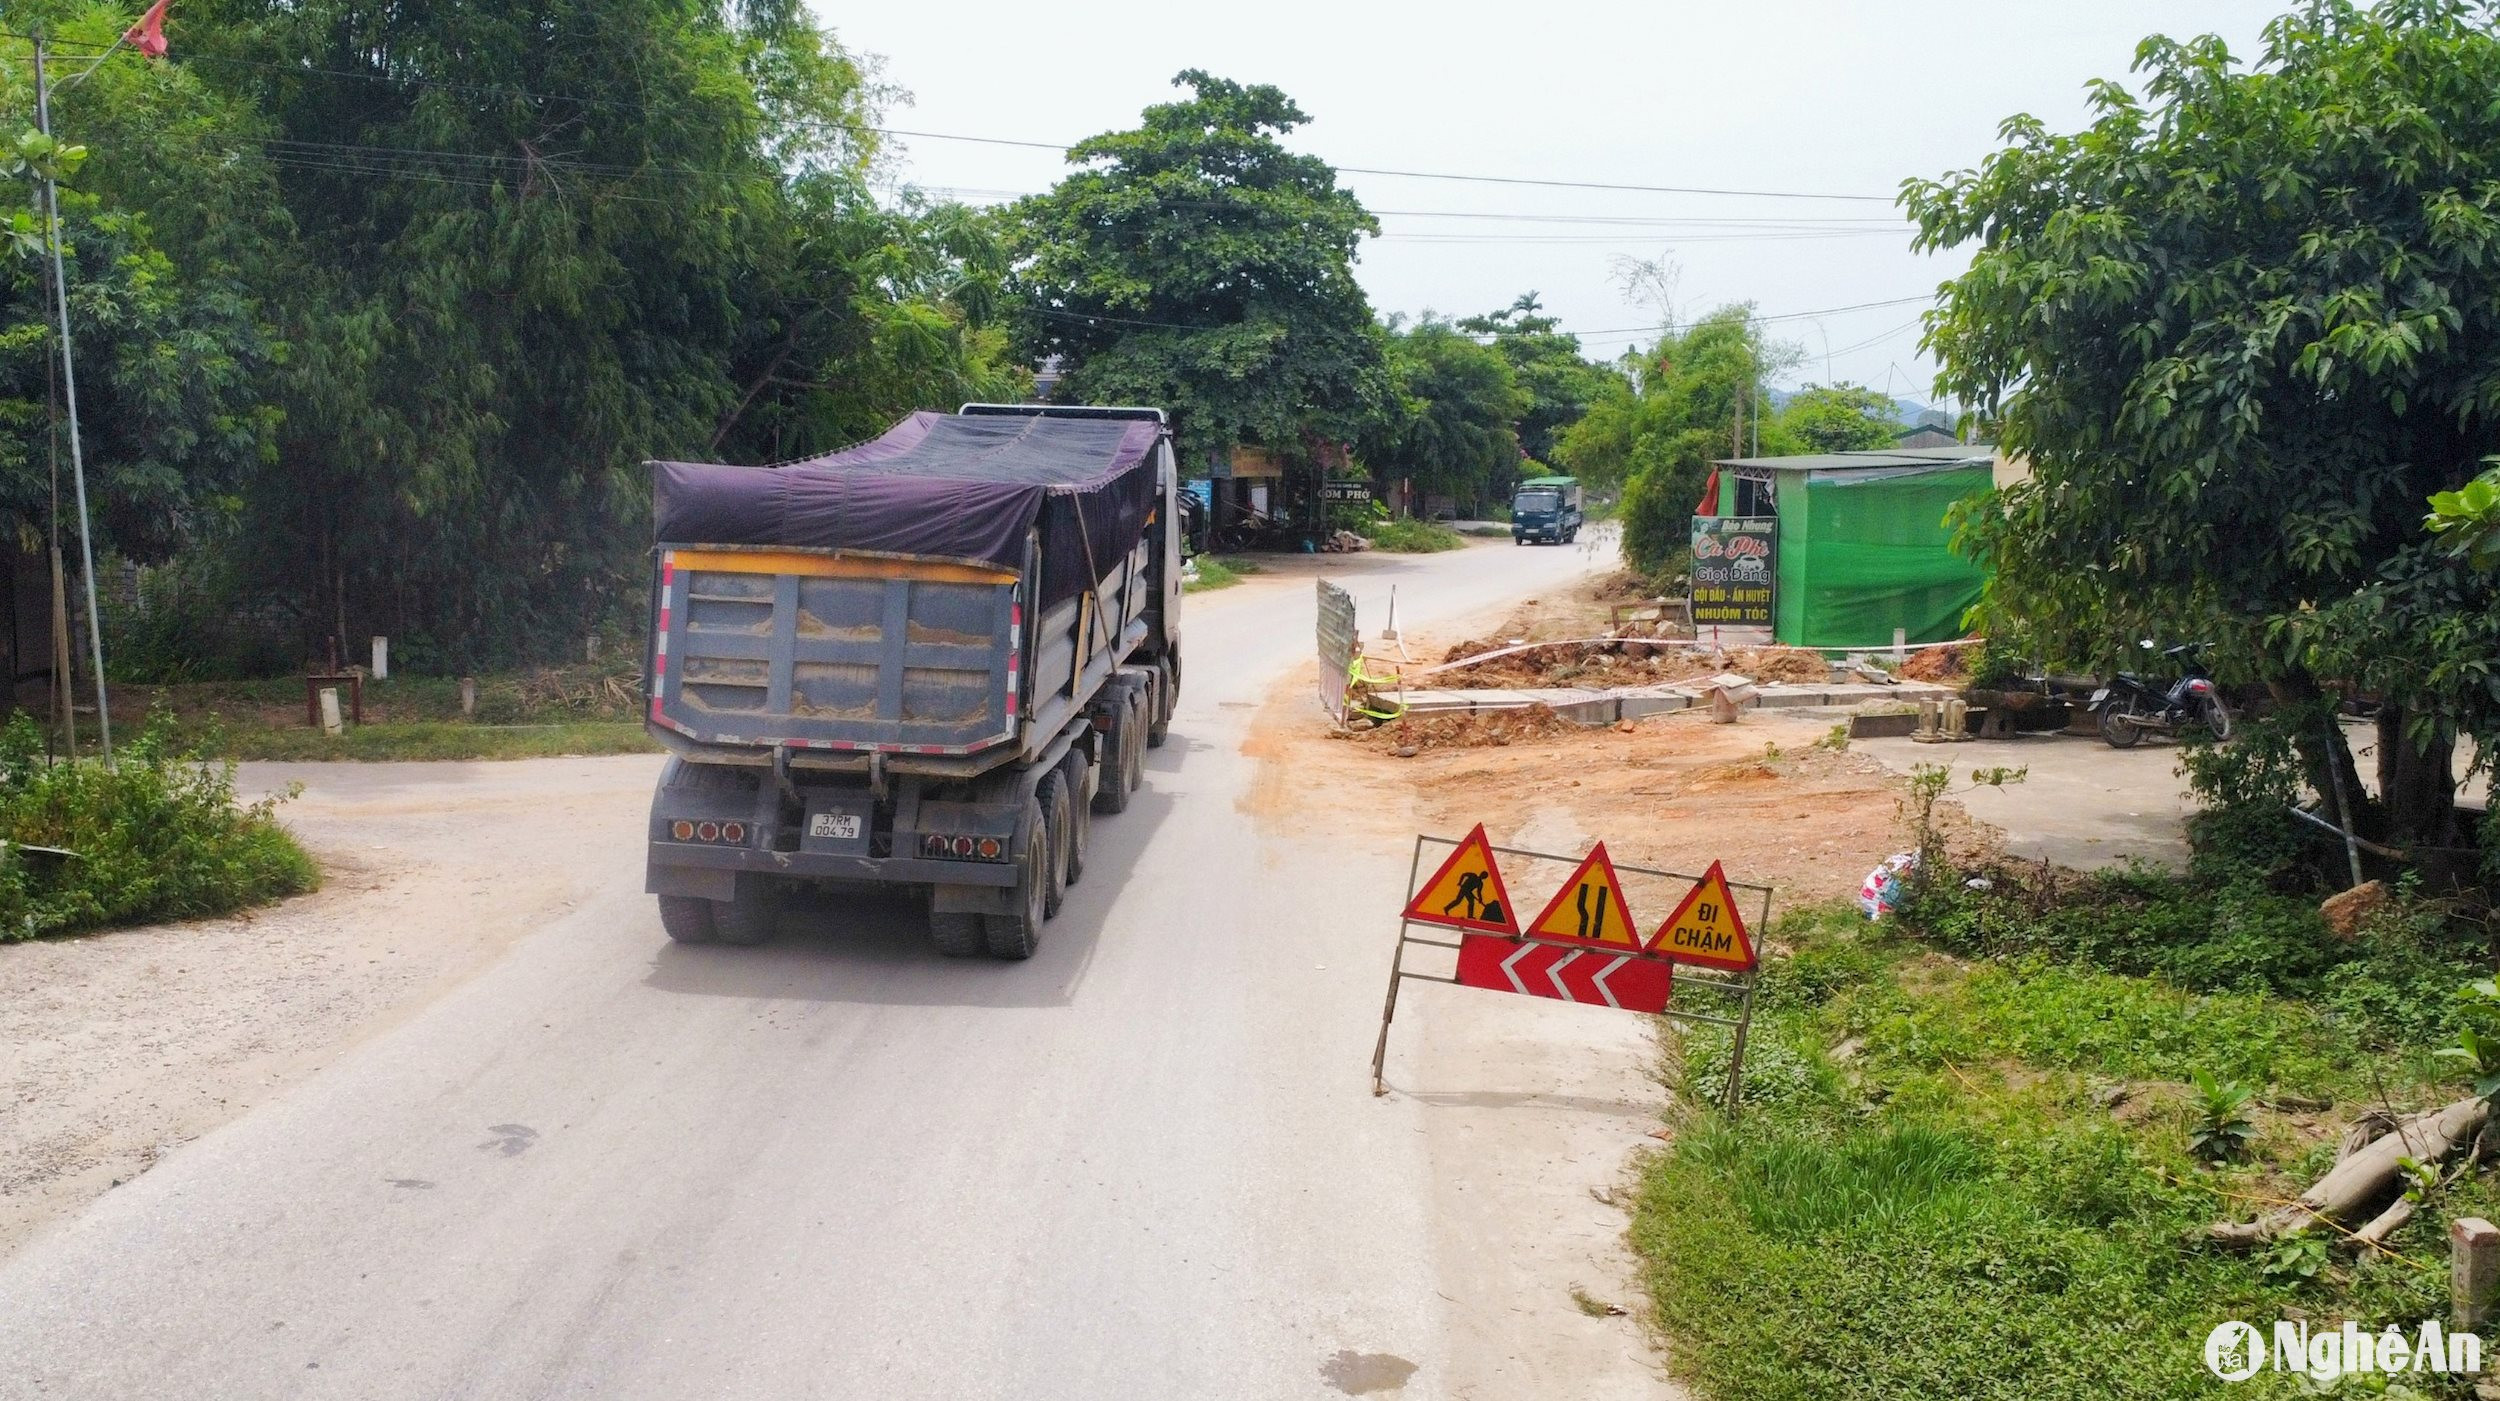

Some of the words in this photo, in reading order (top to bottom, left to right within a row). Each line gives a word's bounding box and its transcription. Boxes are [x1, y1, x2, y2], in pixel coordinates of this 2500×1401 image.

[1346, 488, 1371, 499] PHỞ
[1725, 536, 1770, 559] Phê
[1696, 566, 1728, 584] Giọt
[1694, 586, 1708, 604] GỘI
[1695, 606, 1741, 621] NHUỘM
[1745, 606, 1768, 620] TÓC
[822, 815, 851, 826] 37RM
[815, 825, 855, 837] 004.79
[1698, 903, 1718, 923] ĐI
[1674, 926, 1733, 953] CHẬM
